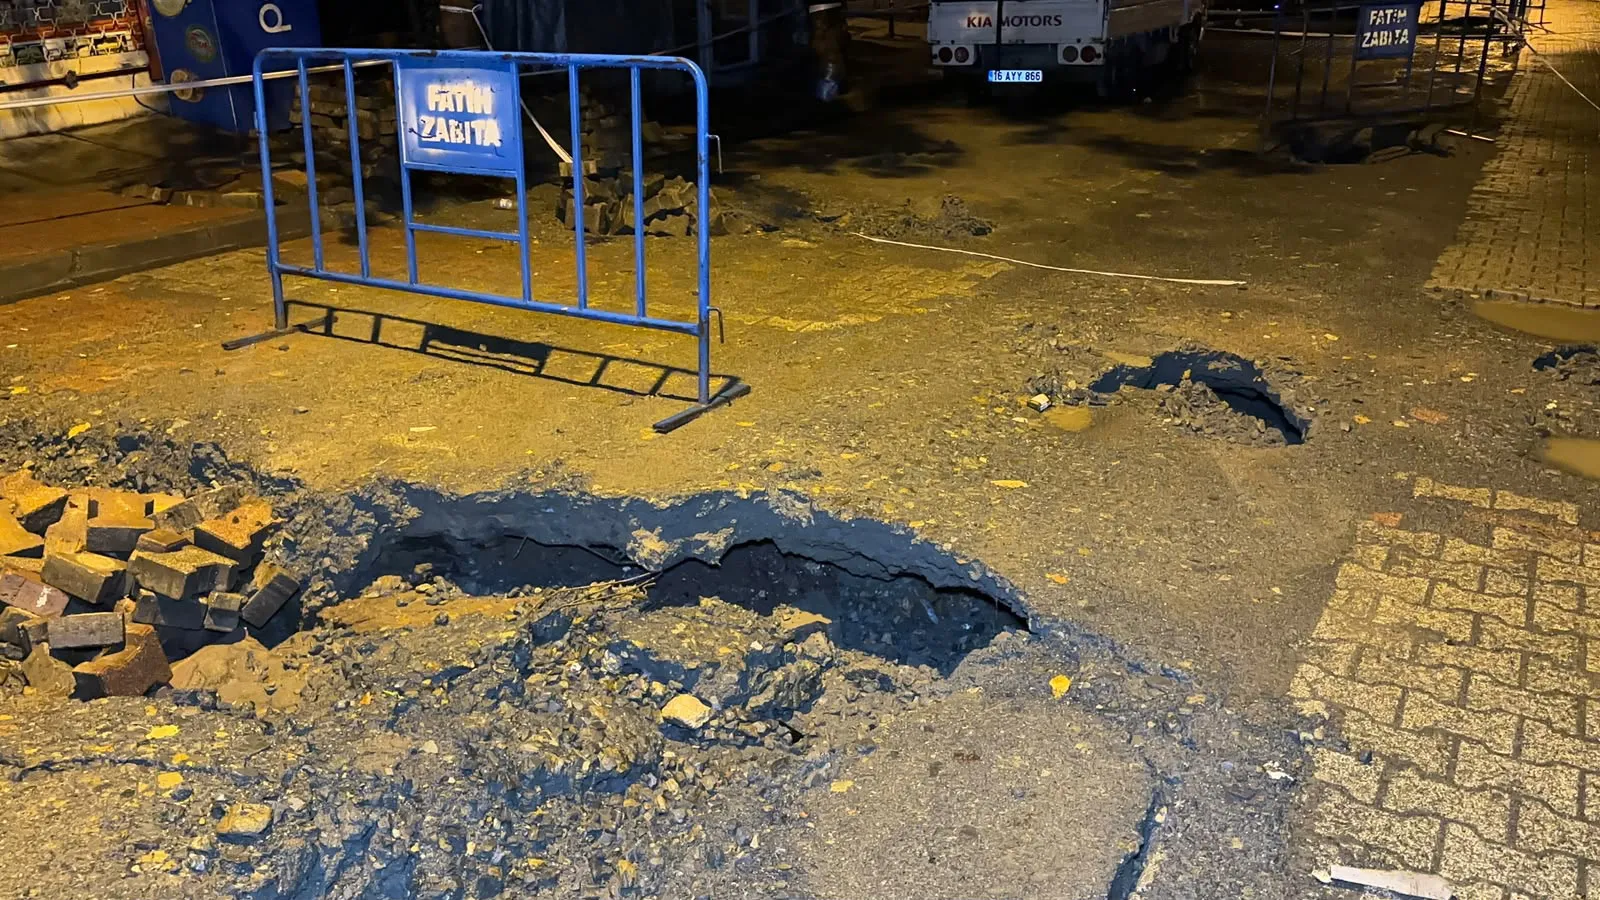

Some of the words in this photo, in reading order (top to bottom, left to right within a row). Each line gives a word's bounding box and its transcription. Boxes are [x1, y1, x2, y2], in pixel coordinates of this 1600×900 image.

[967, 16, 992, 28] KIA
[1000, 15, 1062, 27] MOTORS
[1361, 28, 1409, 48] ZABITA
[994, 71, 1003, 81] 16
[1005, 71, 1023, 81] AYY
[1025, 71, 1041, 81] 866
[420, 115, 501, 147] ZABITA
